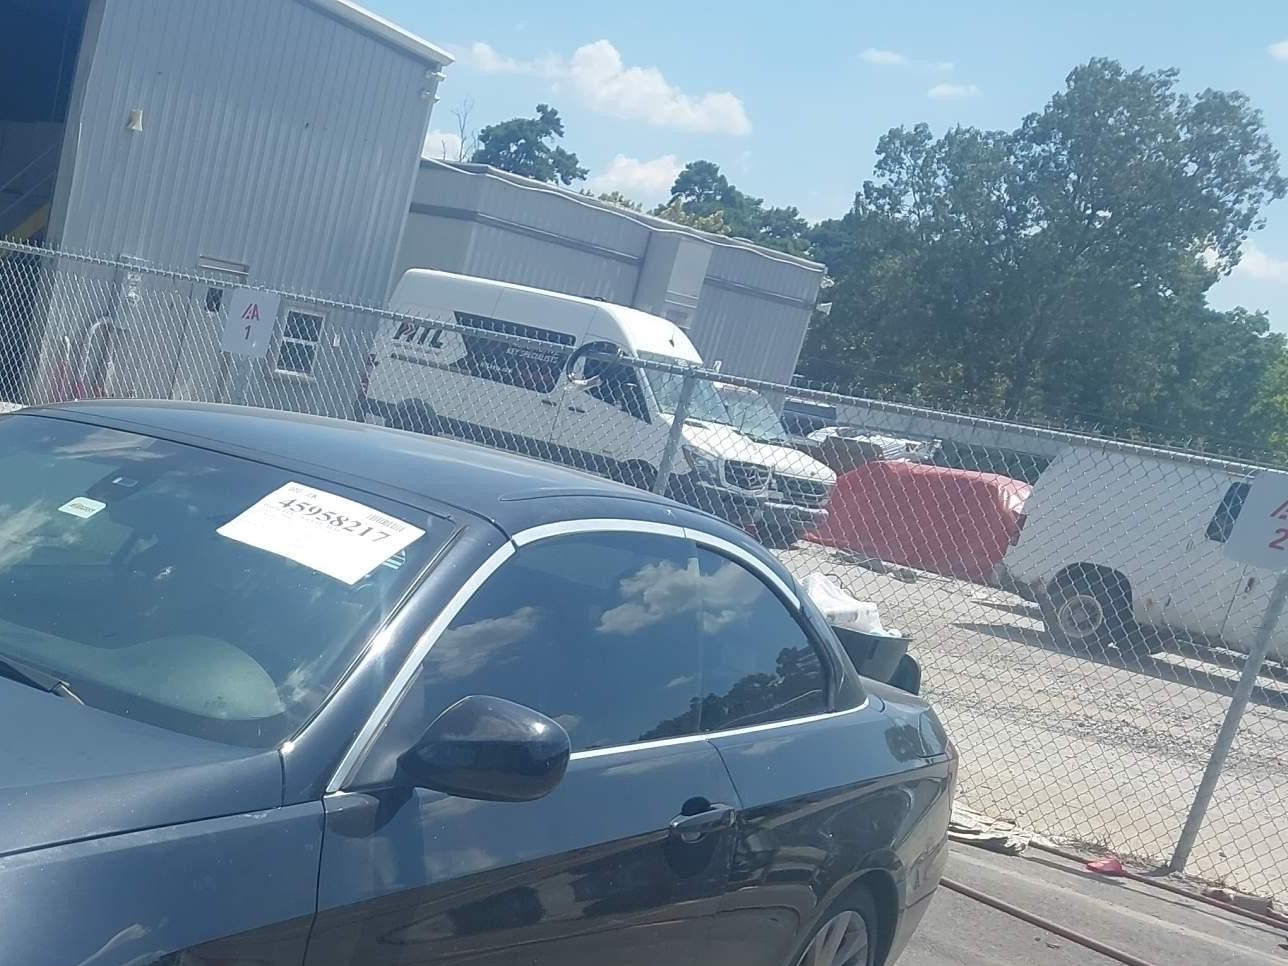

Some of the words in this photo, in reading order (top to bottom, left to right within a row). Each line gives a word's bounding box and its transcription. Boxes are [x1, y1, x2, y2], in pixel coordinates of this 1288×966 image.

[245, 325, 252, 340] 1
[278, 498, 391, 543] 45958217
[1268, 528, 1288, 551] 2
